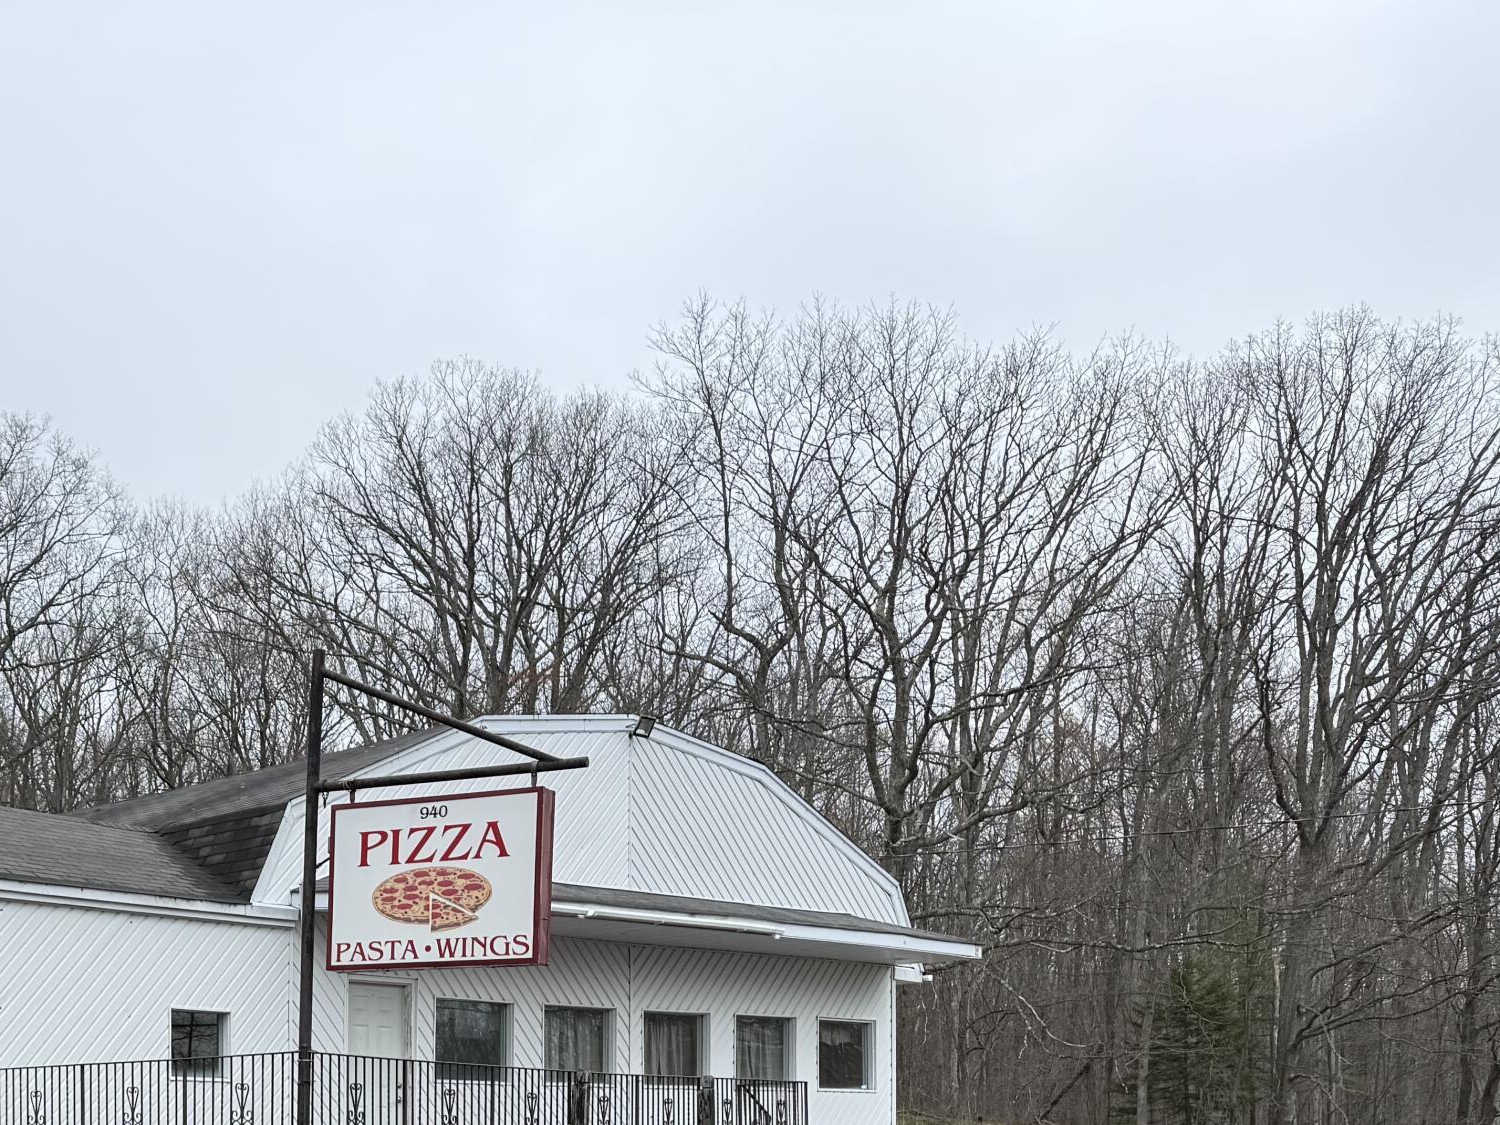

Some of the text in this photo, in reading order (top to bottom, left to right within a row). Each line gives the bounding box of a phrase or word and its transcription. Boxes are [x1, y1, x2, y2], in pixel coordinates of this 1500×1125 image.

[419, 804, 448, 820] 940
[357, 820, 511, 868] PIZZA
[335, 934, 531, 963] PASTA WINGS
